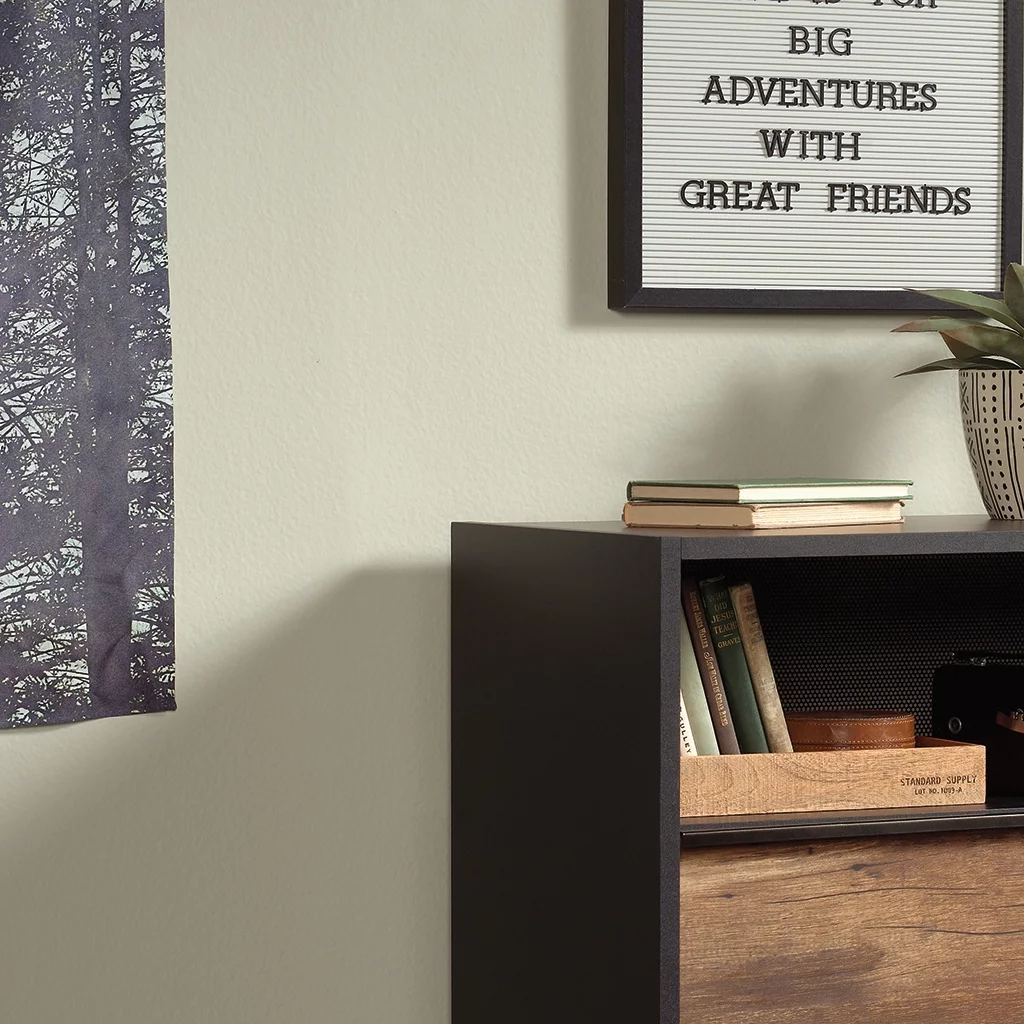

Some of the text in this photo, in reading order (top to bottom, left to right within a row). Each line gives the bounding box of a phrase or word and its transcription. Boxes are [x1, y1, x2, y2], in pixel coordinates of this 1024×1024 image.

[788, 25, 853, 56] BIG
[701, 75, 938, 112] ADVENTURES
[759, 128, 861, 161] WITH
[680, 179, 972, 215] GREAT FRIENDS
[711, 610, 735, 624] JESUS
[714, 602, 728, 611] DID
[694, 611, 704, 629] JAMES
[699, 627, 709, 649] WALLER
[717, 636, 741, 648] GRAVES
[900, 775, 977, 786] STANDARD SUPPLY
